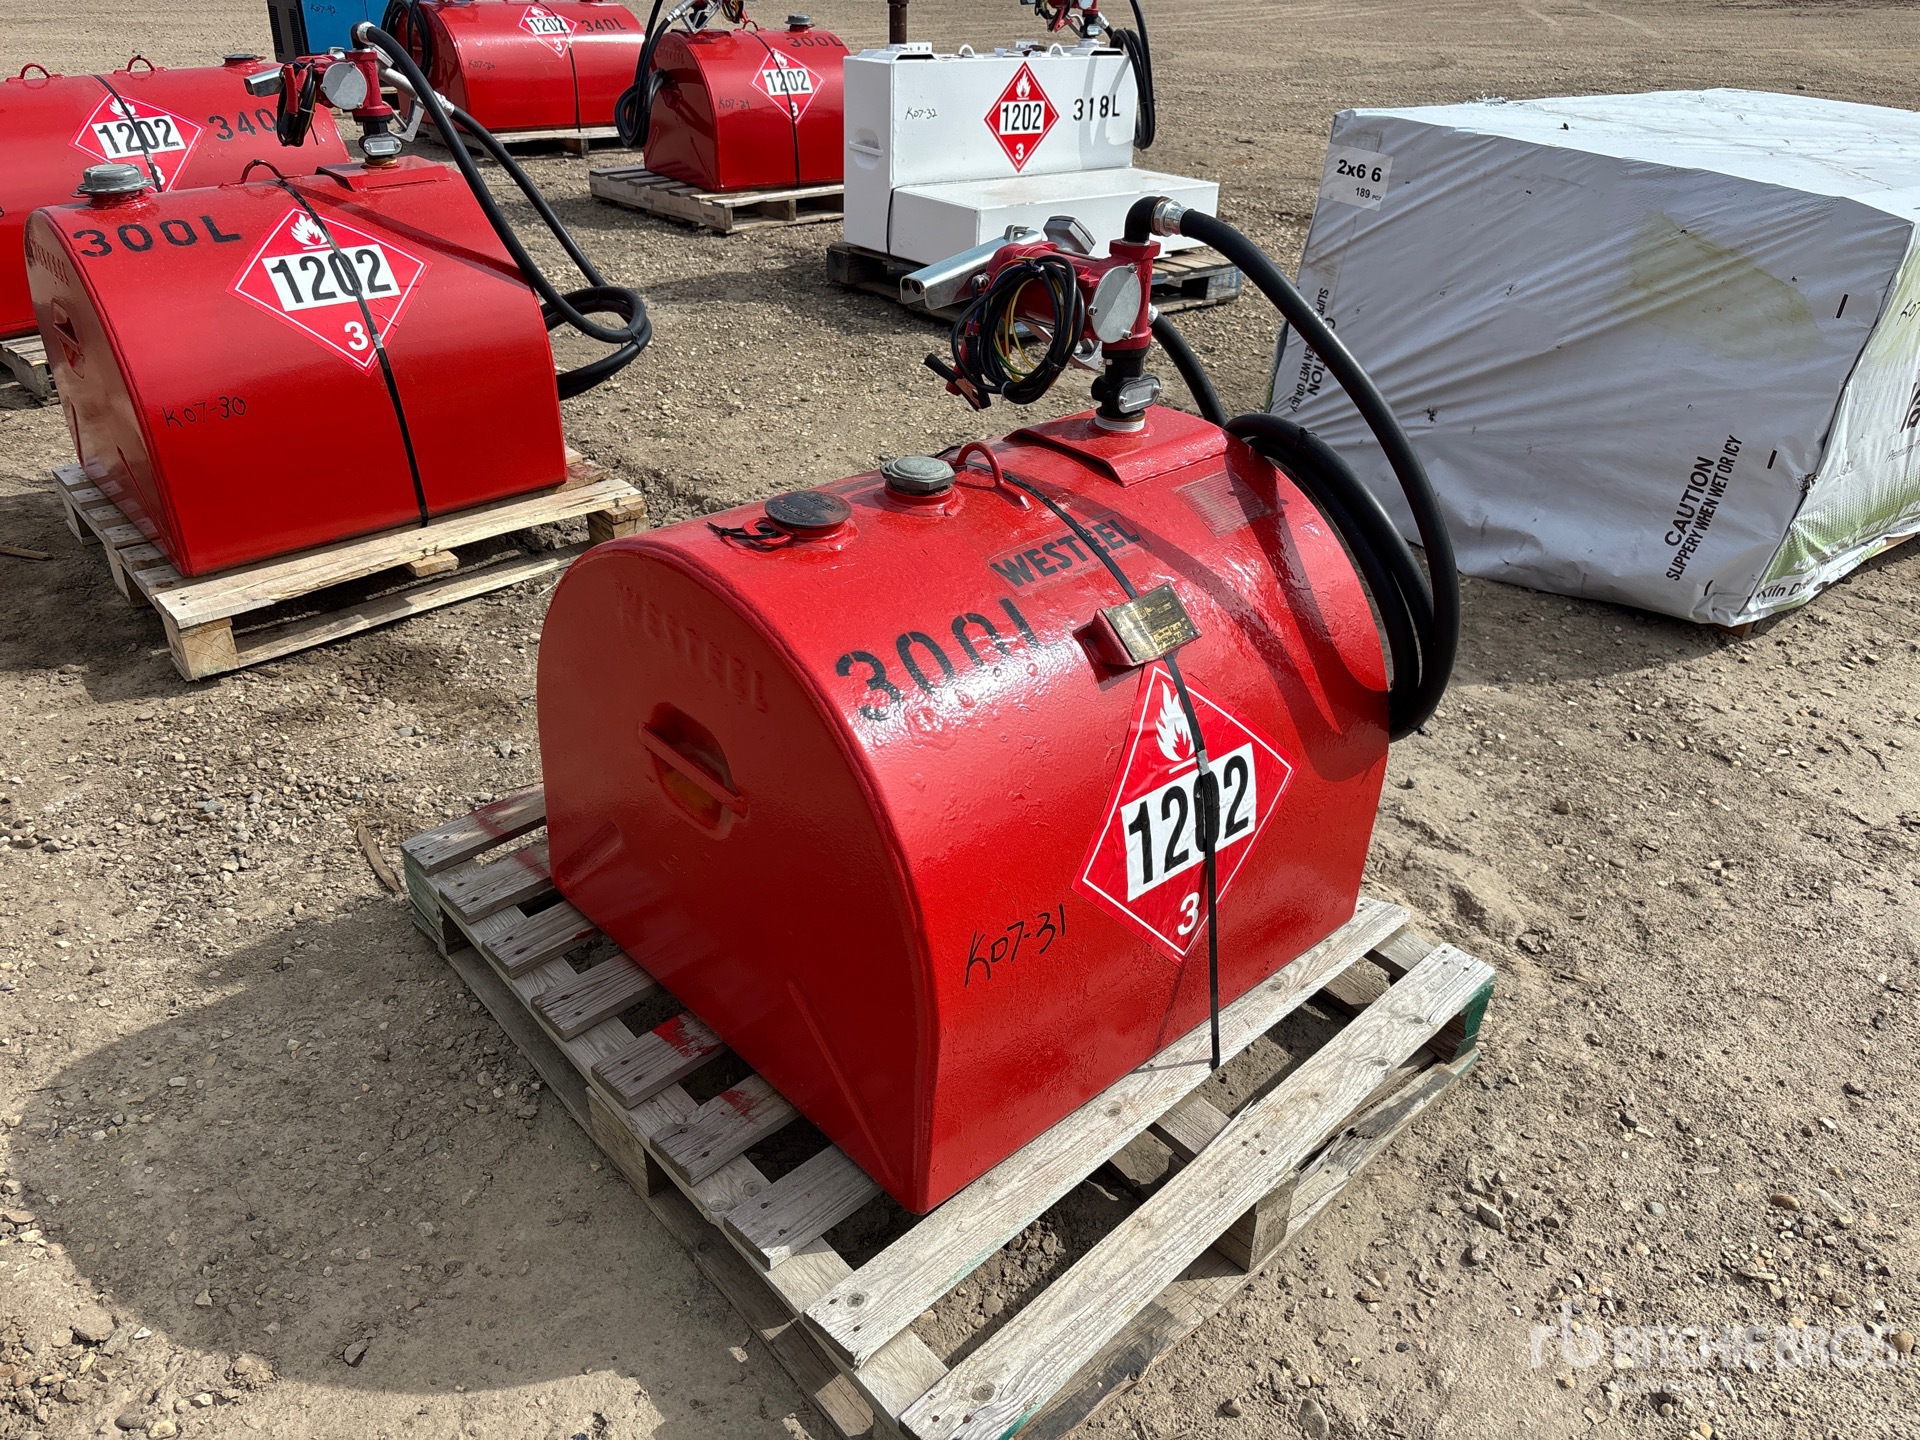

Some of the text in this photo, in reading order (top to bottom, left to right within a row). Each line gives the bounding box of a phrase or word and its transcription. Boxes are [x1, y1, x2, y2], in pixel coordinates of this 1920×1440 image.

[528, 18, 568, 33] 1202
[581, 18, 628, 33] 340L
[553, 37, 563, 51] 3
[786, 36, 845, 48] 300L
[766, 70, 810, 93] 1202
[790, 101, 799, 117] 3
[904, 106, 939, 121] K07-32
[1002, 103, 1043, 132] 1202
[1072, 95, 1121, 122] 318L
[97, 118, 180, 154] 1202
[208, 108, 278, 141] 340
[1015, 143, 1025, 160] 3
[1336, 159, 1382, 183] 2x6 6
[1355, 187, 1371, 199] 189
[72, 215, 242, 258] 300L
[270, 248, 393, 304] 1202
[344, 320, 369, 351] 3
[1299, 362, 1312, 384] WET
[1295, 383, 1306, 397] OR
[161, 396, 247, 428] K07-30
[1664, 456, 1715, 546] CAUTION
[1665, 434, 1743, 581] SLIPPERY WHEN WET OR ICY
[1128, 754, 1250, 885] 1202
[1177, 891, 1200, 937] 3
[964, 903, 1066, 988] K07-31
